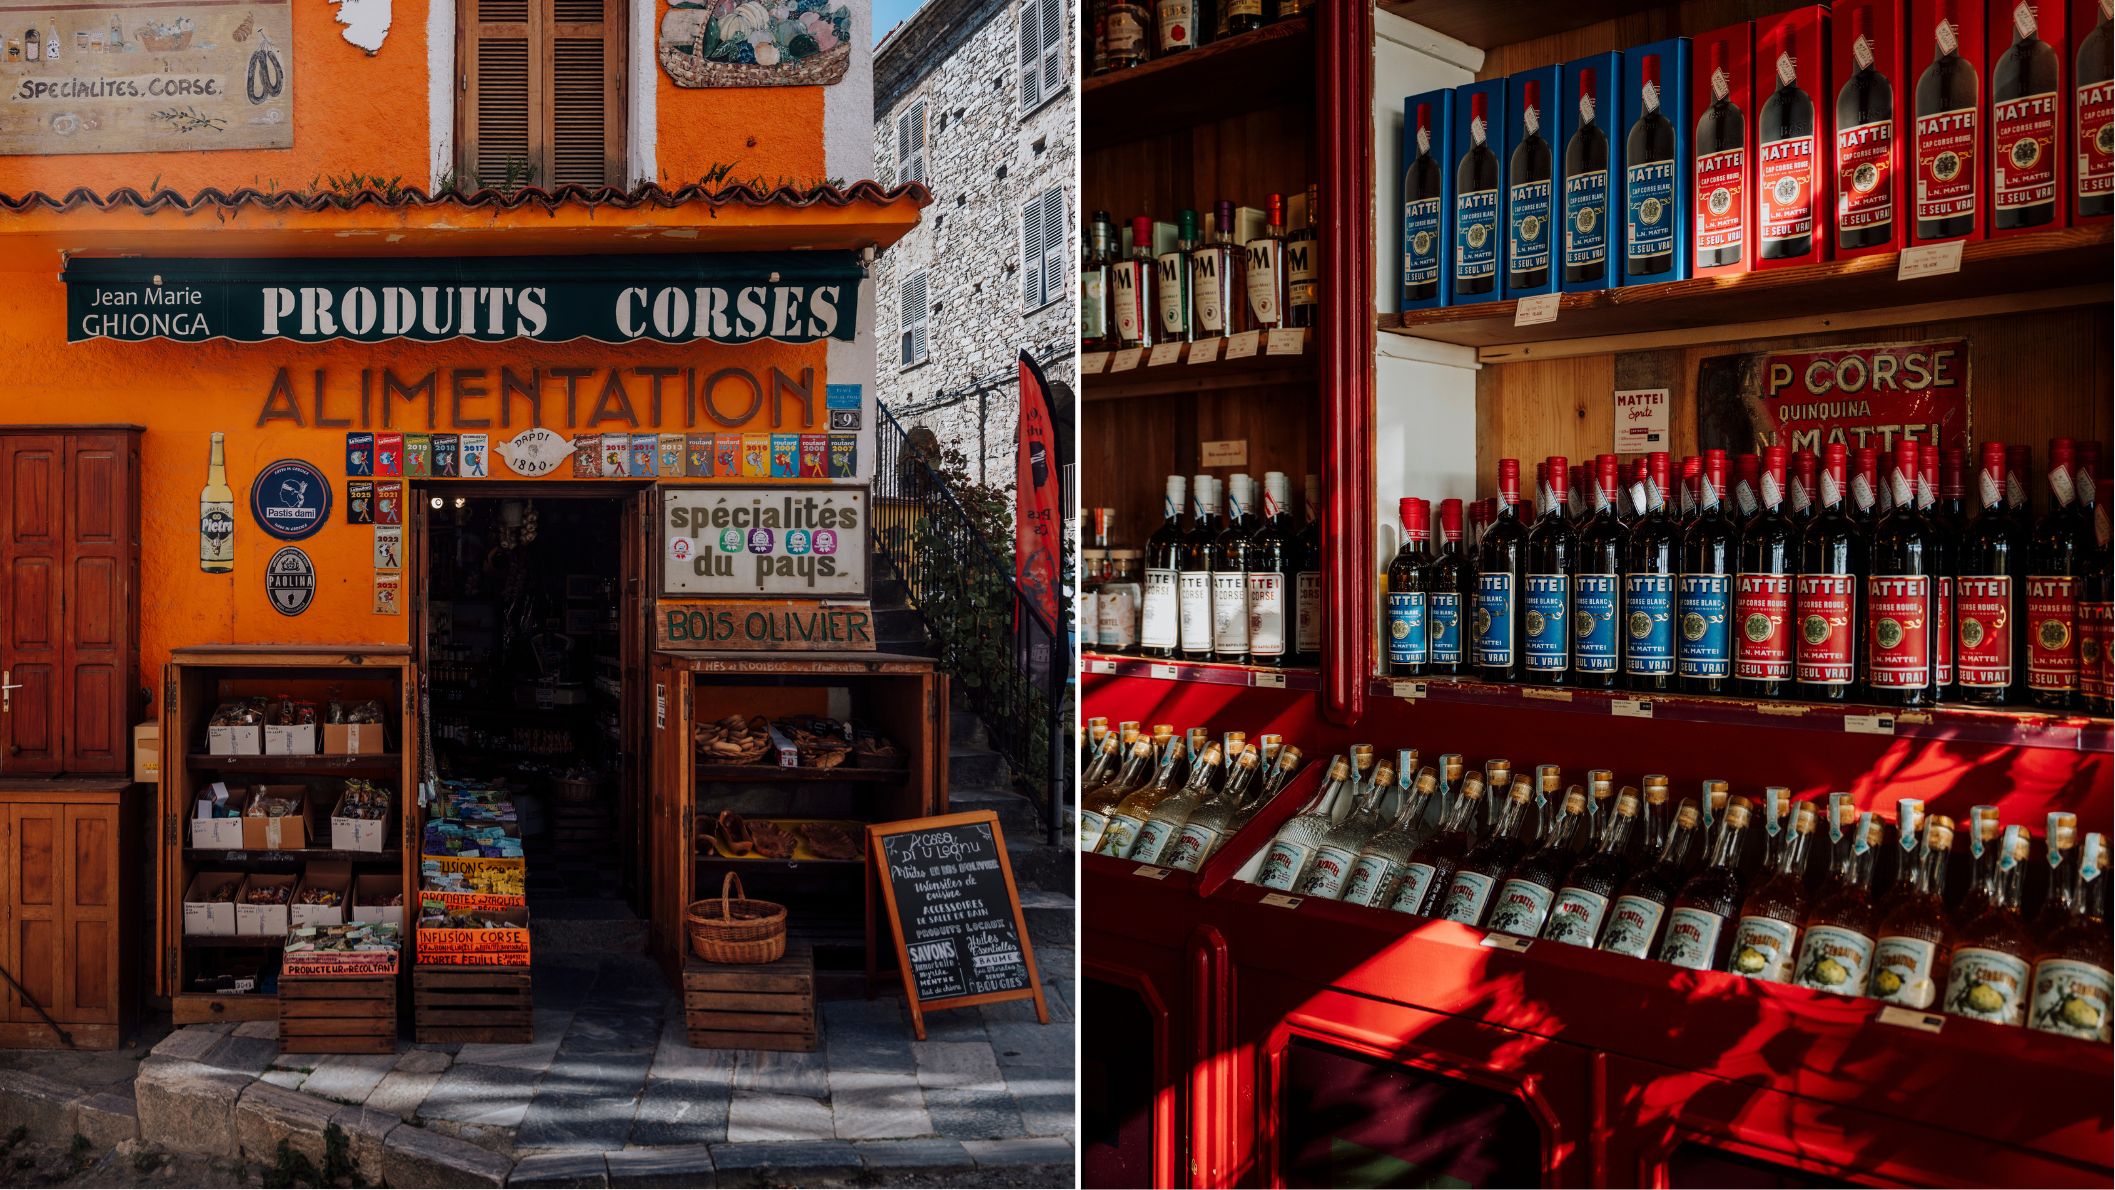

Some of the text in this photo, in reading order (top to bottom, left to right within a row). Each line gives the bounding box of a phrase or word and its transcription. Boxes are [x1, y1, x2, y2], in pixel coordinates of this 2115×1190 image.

[2008, 193, 2031, 203] SEUL
[1930, 202, 1952, 214] SEUL
[1851, 213, 1871, 224] SEUL
[1771, 225, 1791, 235] SEUL
[1707, 234, 1724, 245] SEUL
[1637, 243, 1655, 253] SEUL
[92, 287, 202, 306] Jean Marie
[262, 286, 840, 338] PRODUITS CORSES
[82, 313, 211, 336] GHIONGA
[1805, 350, 1959, 396] CORSE
[256, 366, 814, 428] ALIMENTATION
[1618, 393, 1663, 406] MATTEI
[1779, 400, 1871, 423] QUINQUINA
[842, 413, 852, 427] 9
[1792, 423, 1941, 457] MATTEI
[268, 509, 293, 517] Pastis
[670, 497, 858, 538] spécialités
[694, 546, 734, 577] du
[269, 576, 313, 588] PAOLINA
[1252, 591, 1275, 601] CORSE
[666, 611, 870, 642] BOIS OLIVIER
[1406, 653, 1422, 661] VRAI
[1488, 653, 1507, 662] VRAI
[1542, 657, 1562, 665] VRAI
[1591, 659, 1612, 668] VRAI
[1648, 660, 1670, 670] VRAI
[1702, 663, 1724, 673] VRAI
[1767, 665, 1788, 675] VRAI
[1825, 668, 1848, 678] VRAI
[1899, 672, 1923, 683] VRAI
[1981, 672, 2005, 682] VRAI
[2036, 674, 2059, 684] SEUL
[922, 846, 933, 859] U
[914, 874, 977, 893] Ustensiles de
[926, 889, 962, 901] cuisine
[923, 899, 984, 916] ACCESSOIRES
[916, 917, 927, 926] DE
[928, 913, 953, 924] SALLE
[967, 908, 989, 919] BAIN
[419, 930, 522, 943] INFUSION CORSE
[915, 924, 962, 939] PRODUITS
[966, 930, 999, 953] Huiles
[909, 941, 955, 963] SAVONS
[972, 941, 1018, 956] Essentielles
[461, 953, 503, 966] FEUILLE
[978, 954, 1013, 965] BAUME
[288, 963, 396, 975] PRODUCTEUR RÉCOLTANT
[919, 976, 955, 987] MENTHE
[975, 976, 1023, 993] BOUGIES
